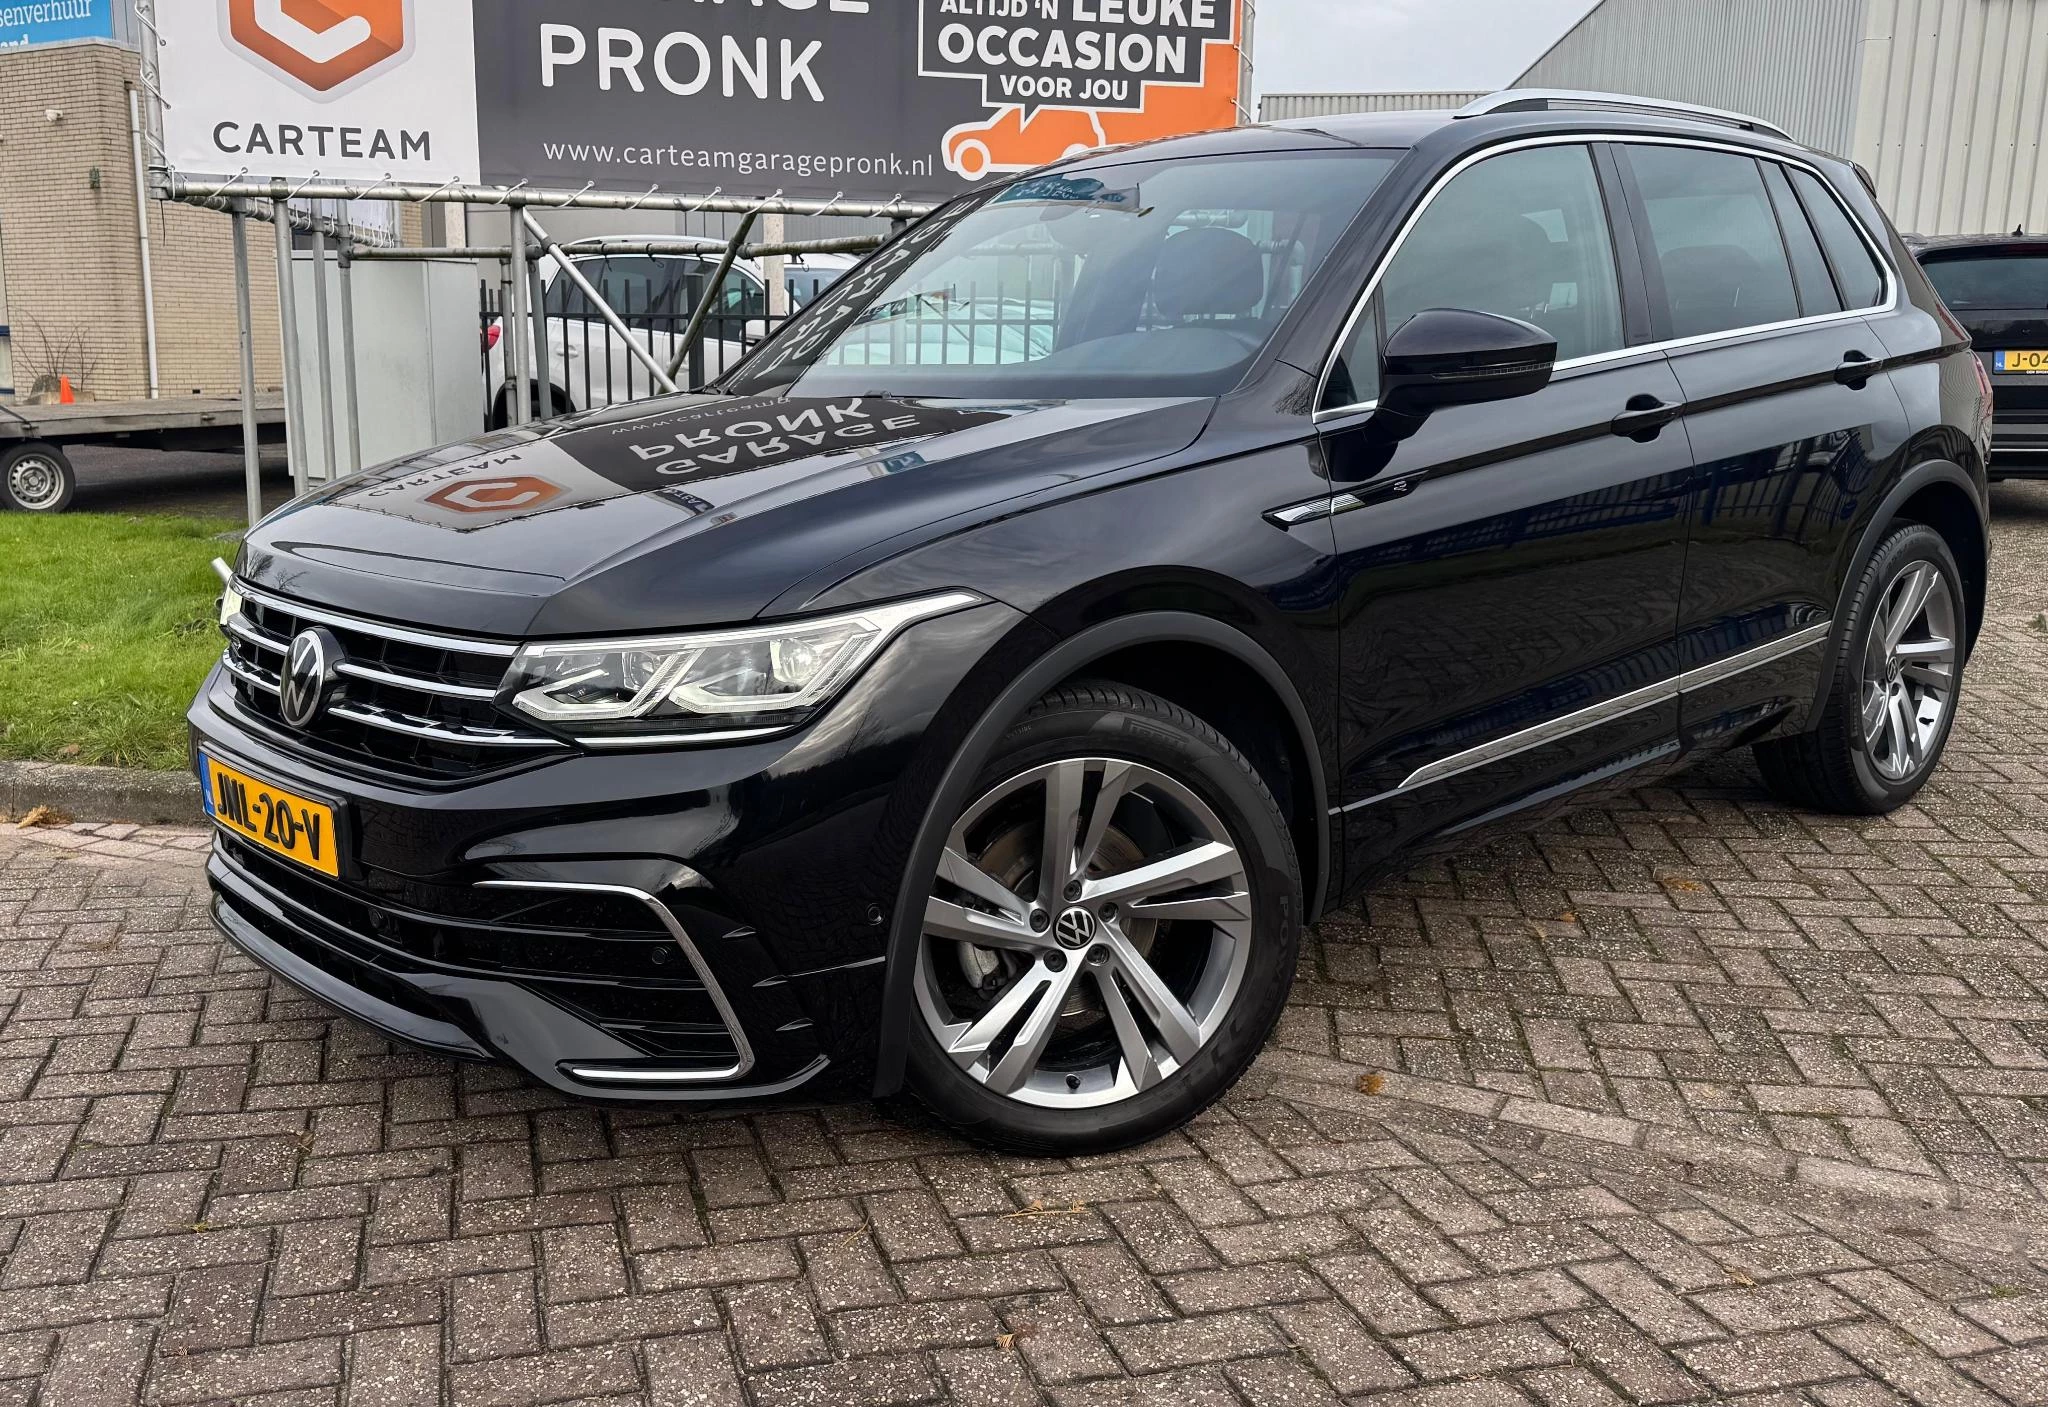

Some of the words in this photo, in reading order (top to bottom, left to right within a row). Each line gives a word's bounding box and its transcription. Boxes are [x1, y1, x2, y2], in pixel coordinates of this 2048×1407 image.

[1072, 0, 1216, 28] LEUKE
[540, 23, 825, 102] PRONK
[937, 23, 1186, 74] OCCASION
[1000, 74, 1072, 98] VOOR
[1079, 78, 1128, 101] JOU
[213, 121, 431, 161] CARTEAM
[543, 142, 932, 177] www.carteamgaragepronk.nl
[216, 771, 320, 861] JNL-20-V
